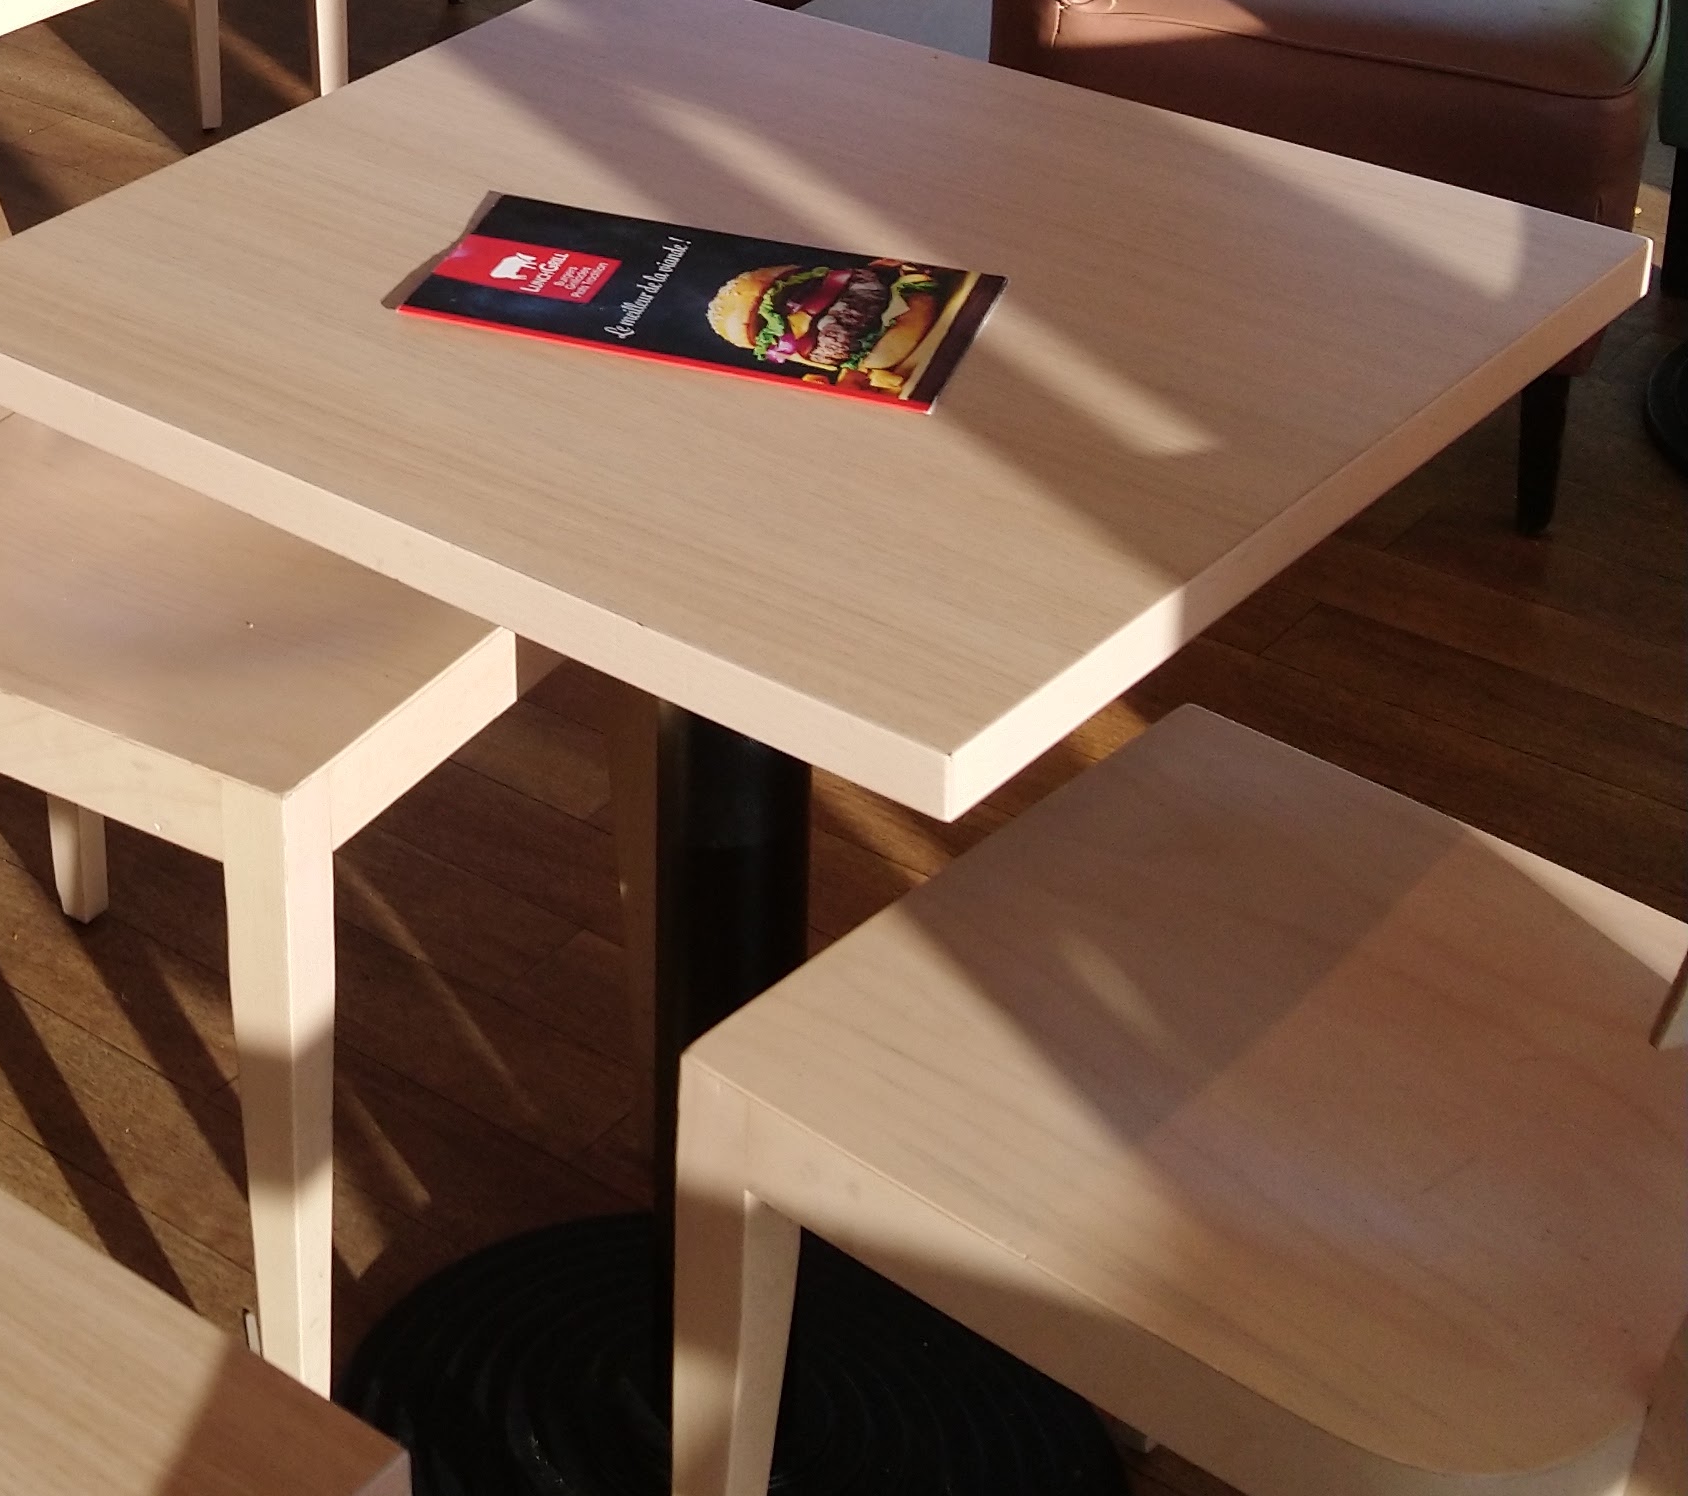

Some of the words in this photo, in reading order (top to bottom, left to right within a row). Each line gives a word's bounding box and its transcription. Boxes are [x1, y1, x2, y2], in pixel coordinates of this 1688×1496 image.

[656, 246, 688, 274] viande
[618, 293, 653, 328] meilleur
[603, 325, 636, 339] Le
